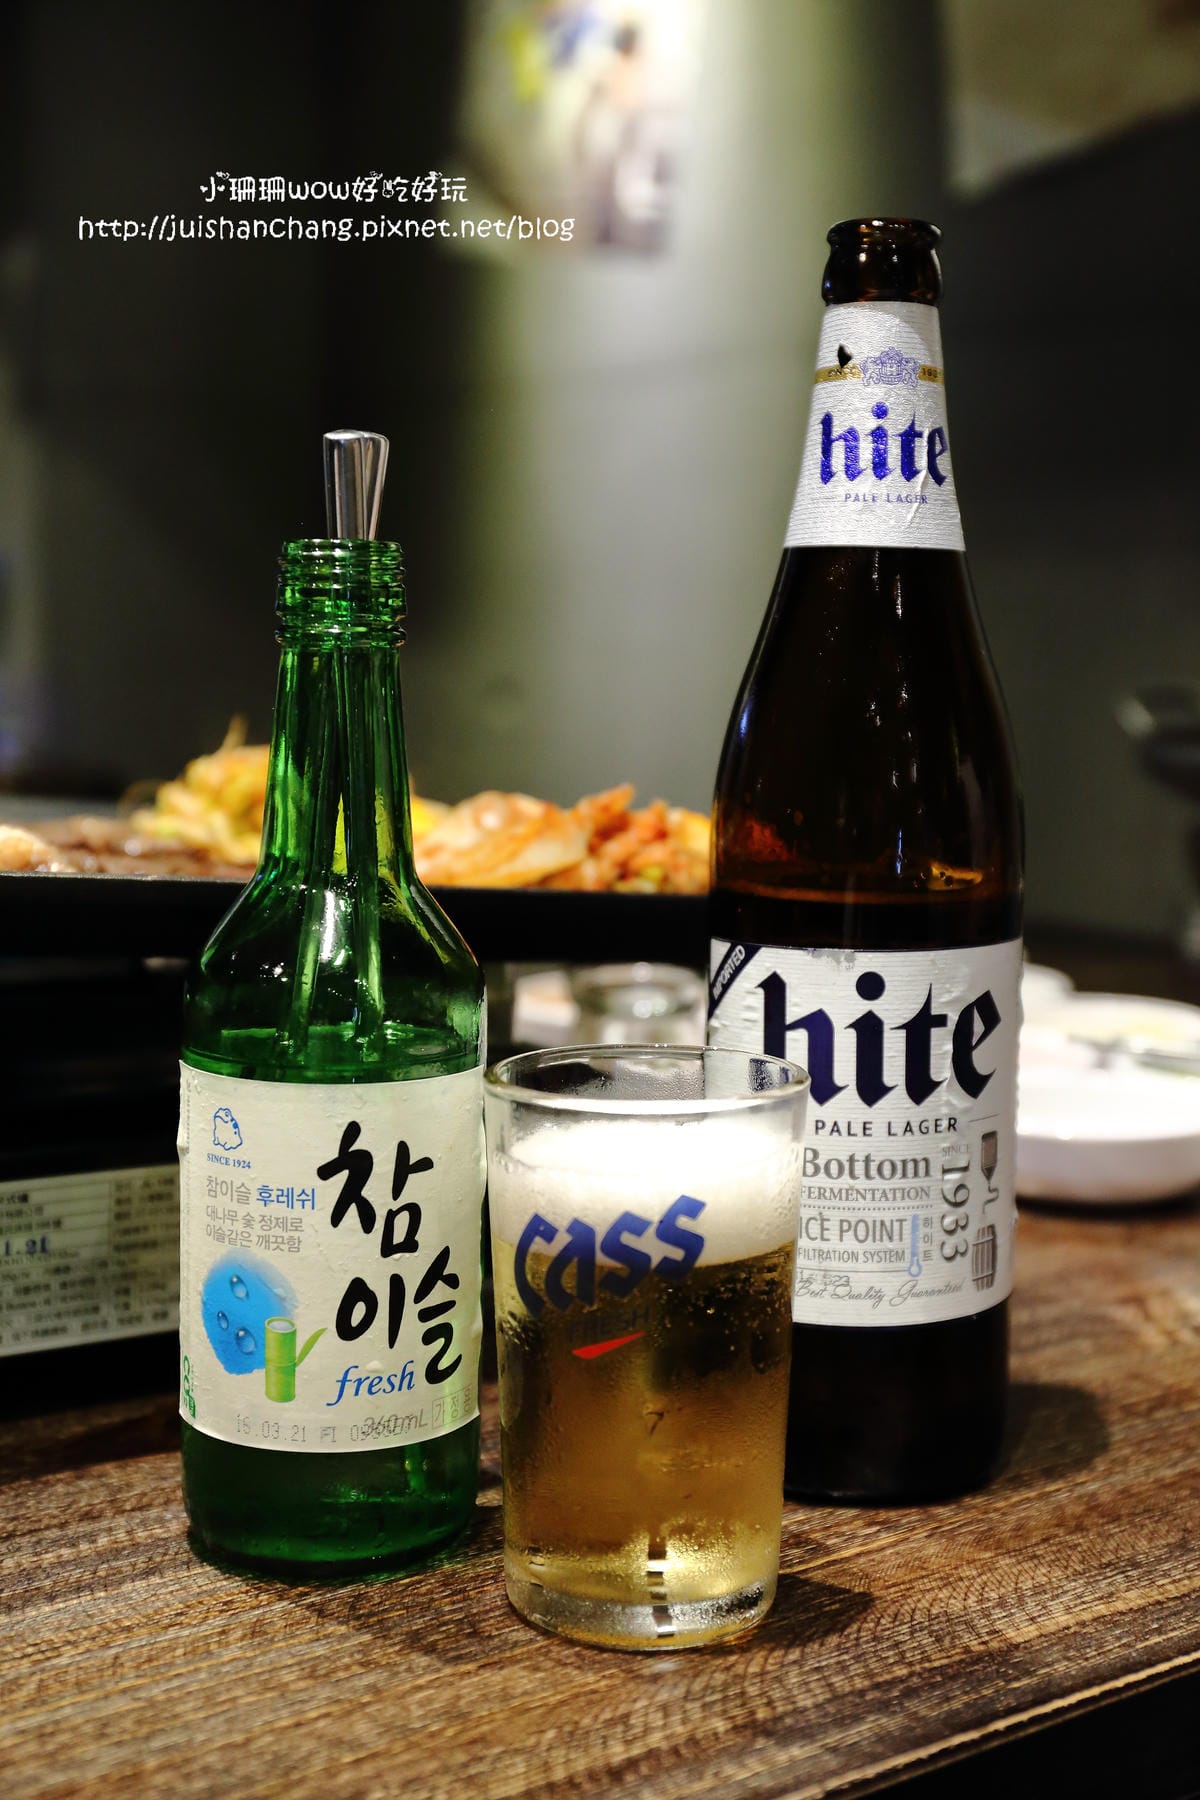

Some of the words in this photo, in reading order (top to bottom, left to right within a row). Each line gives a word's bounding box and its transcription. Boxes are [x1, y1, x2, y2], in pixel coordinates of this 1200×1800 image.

[820, 402, 949, 487] hite
[844, 493, 878, 503] PALE
[886, 494, 928, 504] LAGER
[755, 970, 1001, 1108] hite
[815, 1119, 873, 1137] PALE
[887, 1117, 958, 1137] LAGER
[207, 1153, 231, 1166] SINCE
[232, 1159, 251, 1169] 1924
[802, 1147, 933, 1181] Bottom
[206, 1175, 252, 1205] 참이슬
[256, 1184, 315, 1211] 후레쉬
[206, 1204, 240, 1227] 대나무
[258, 1214, 304, 1233] 정제로
[940, 1159, 971, 1262] 1933
[206, 1223, 253, 1249] 이슬같은
[256, 1233, 303, 1253] 깨끗함
[799, 1216, 831, 1241] ICE
[839, 1218, 907, 1243] POINT
[862, 1250, 906, 1264] SYSTEM
[326, 1359, 416, 1406] fresh
